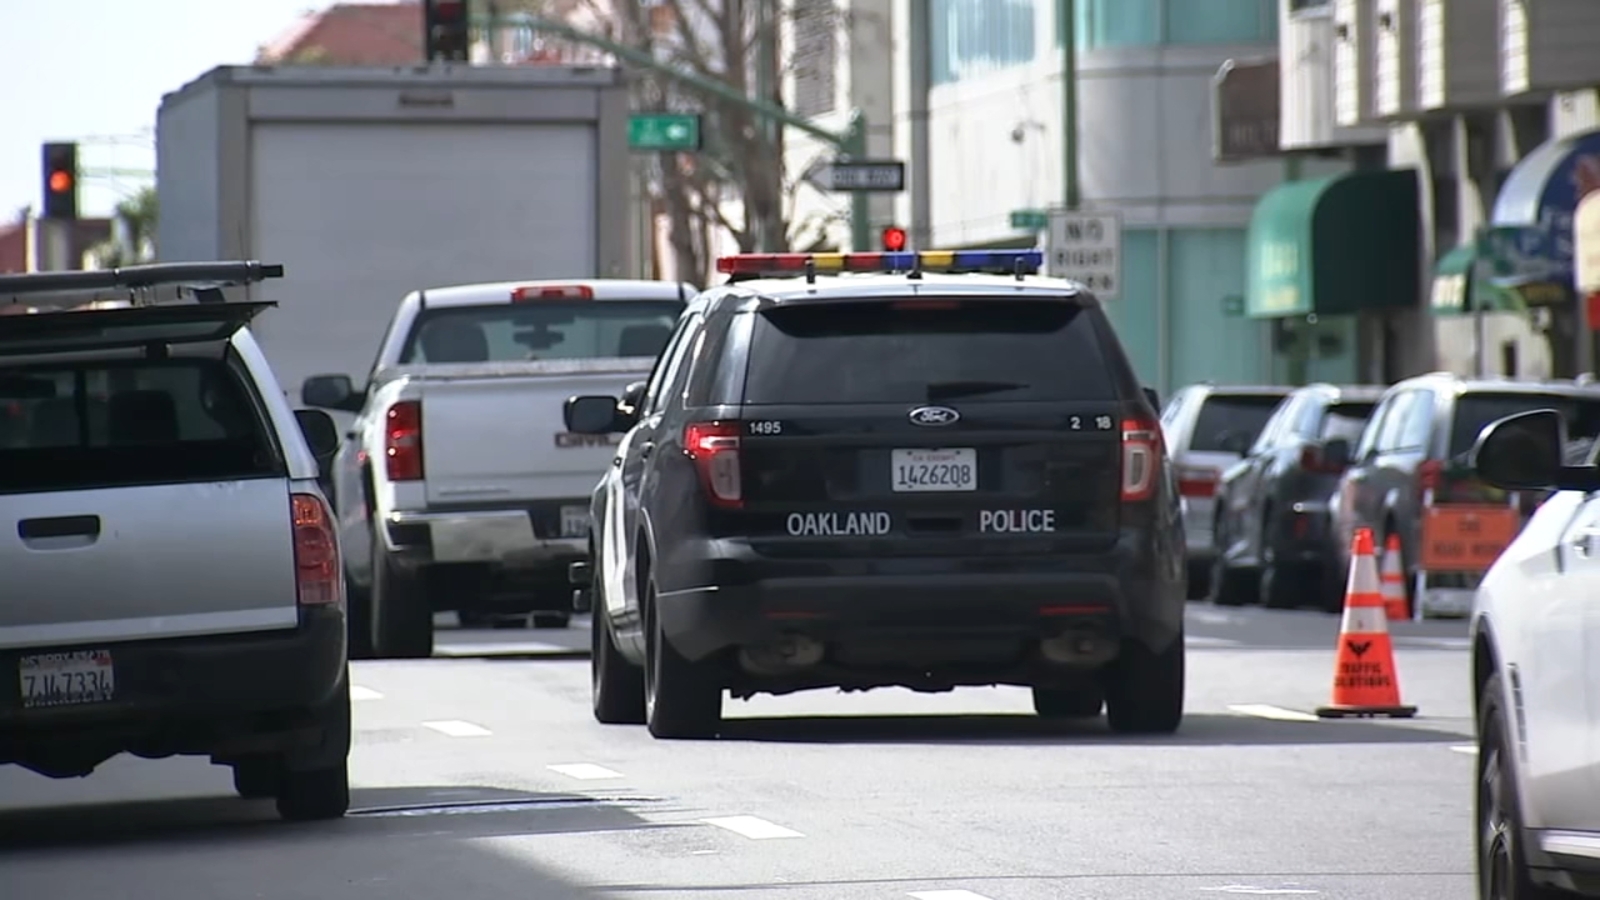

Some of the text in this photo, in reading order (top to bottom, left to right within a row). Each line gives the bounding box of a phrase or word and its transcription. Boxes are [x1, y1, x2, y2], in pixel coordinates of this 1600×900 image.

[1064, 219, 1104, 242] NO
[1056, 248, 1113, 267] RIGHT
[749, 421, 782, 434] 1495
[1070, 416, 1112, 429] 2 18
[898, 464, 971, 486] 1426208
[787, 512, 891, 535] OAKLAND
[980, 510, 1055, 532] POLICE
